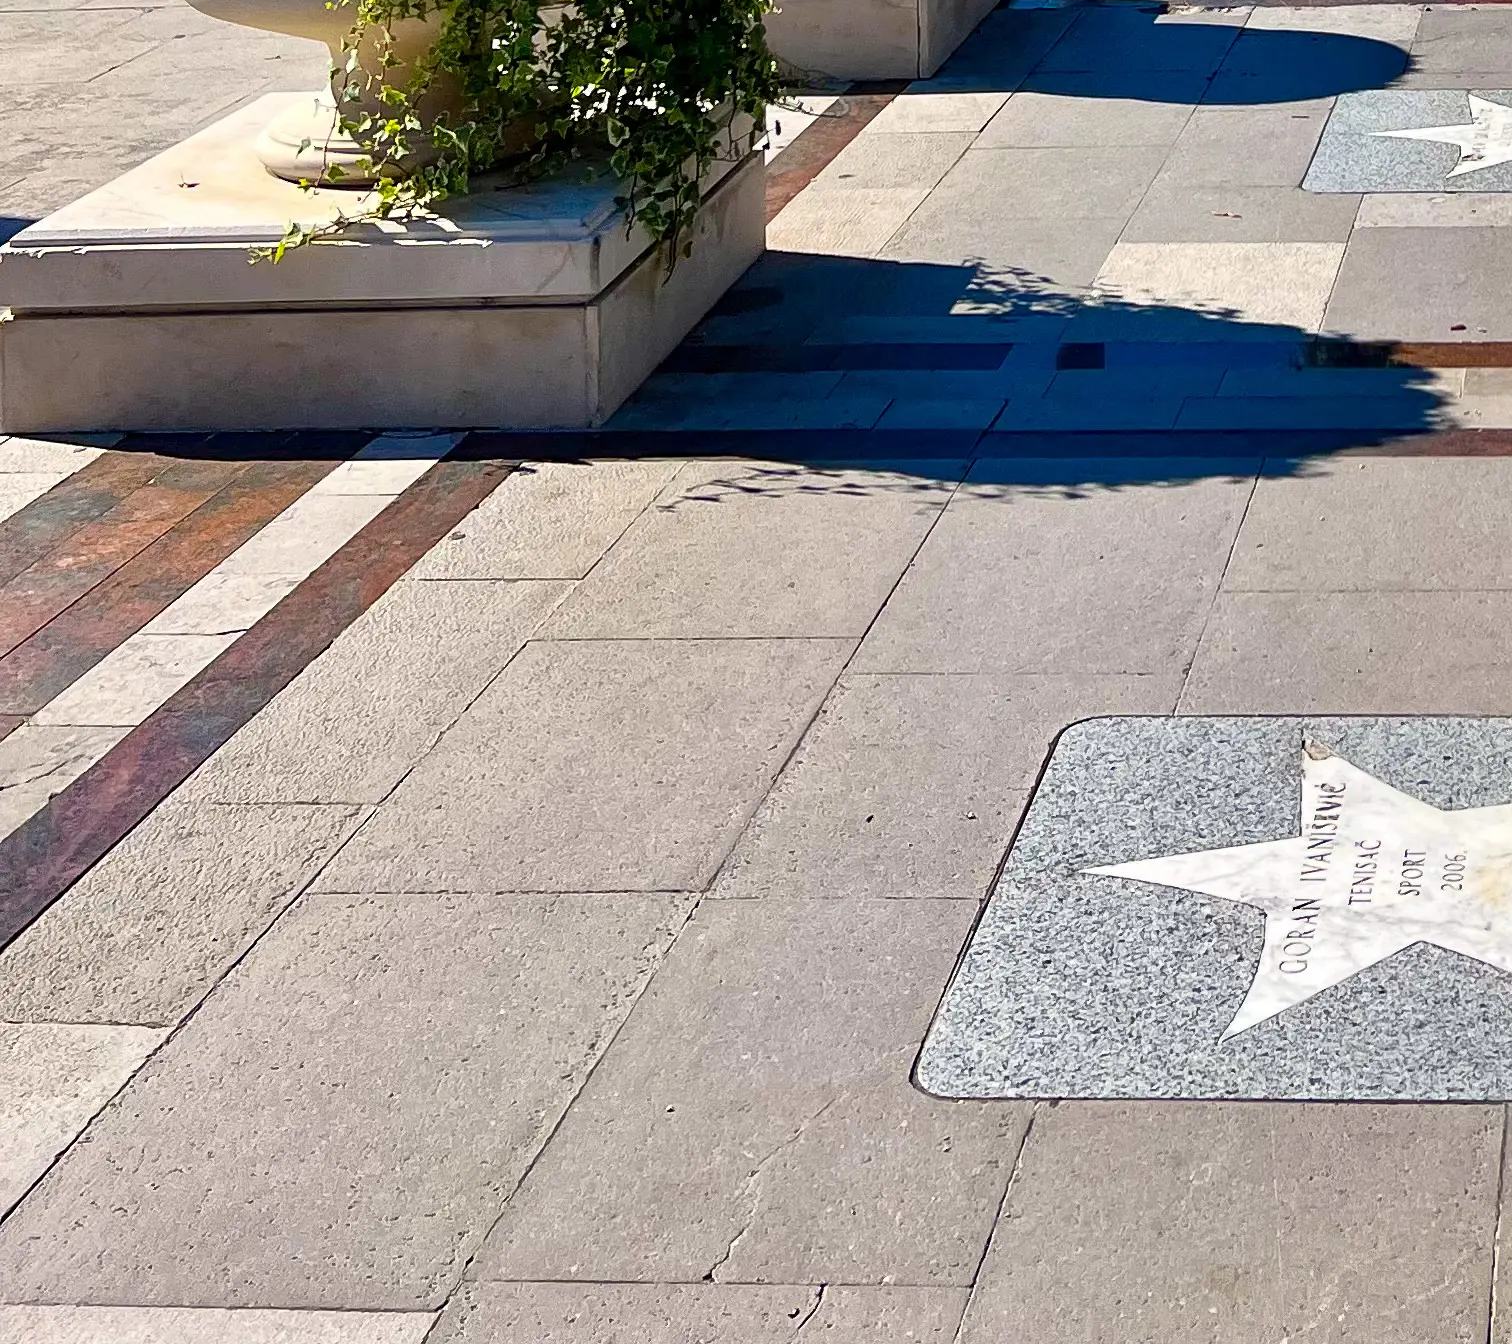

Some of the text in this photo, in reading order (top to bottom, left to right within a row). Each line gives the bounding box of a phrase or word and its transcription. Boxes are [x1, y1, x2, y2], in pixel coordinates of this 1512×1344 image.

[1278, 781, 1347, 974] GORAN IVANIŠEVIĆ
[1348, 839, 1382, 906] TENISAČ
[1397, 848, 1427, 897] SPORT
